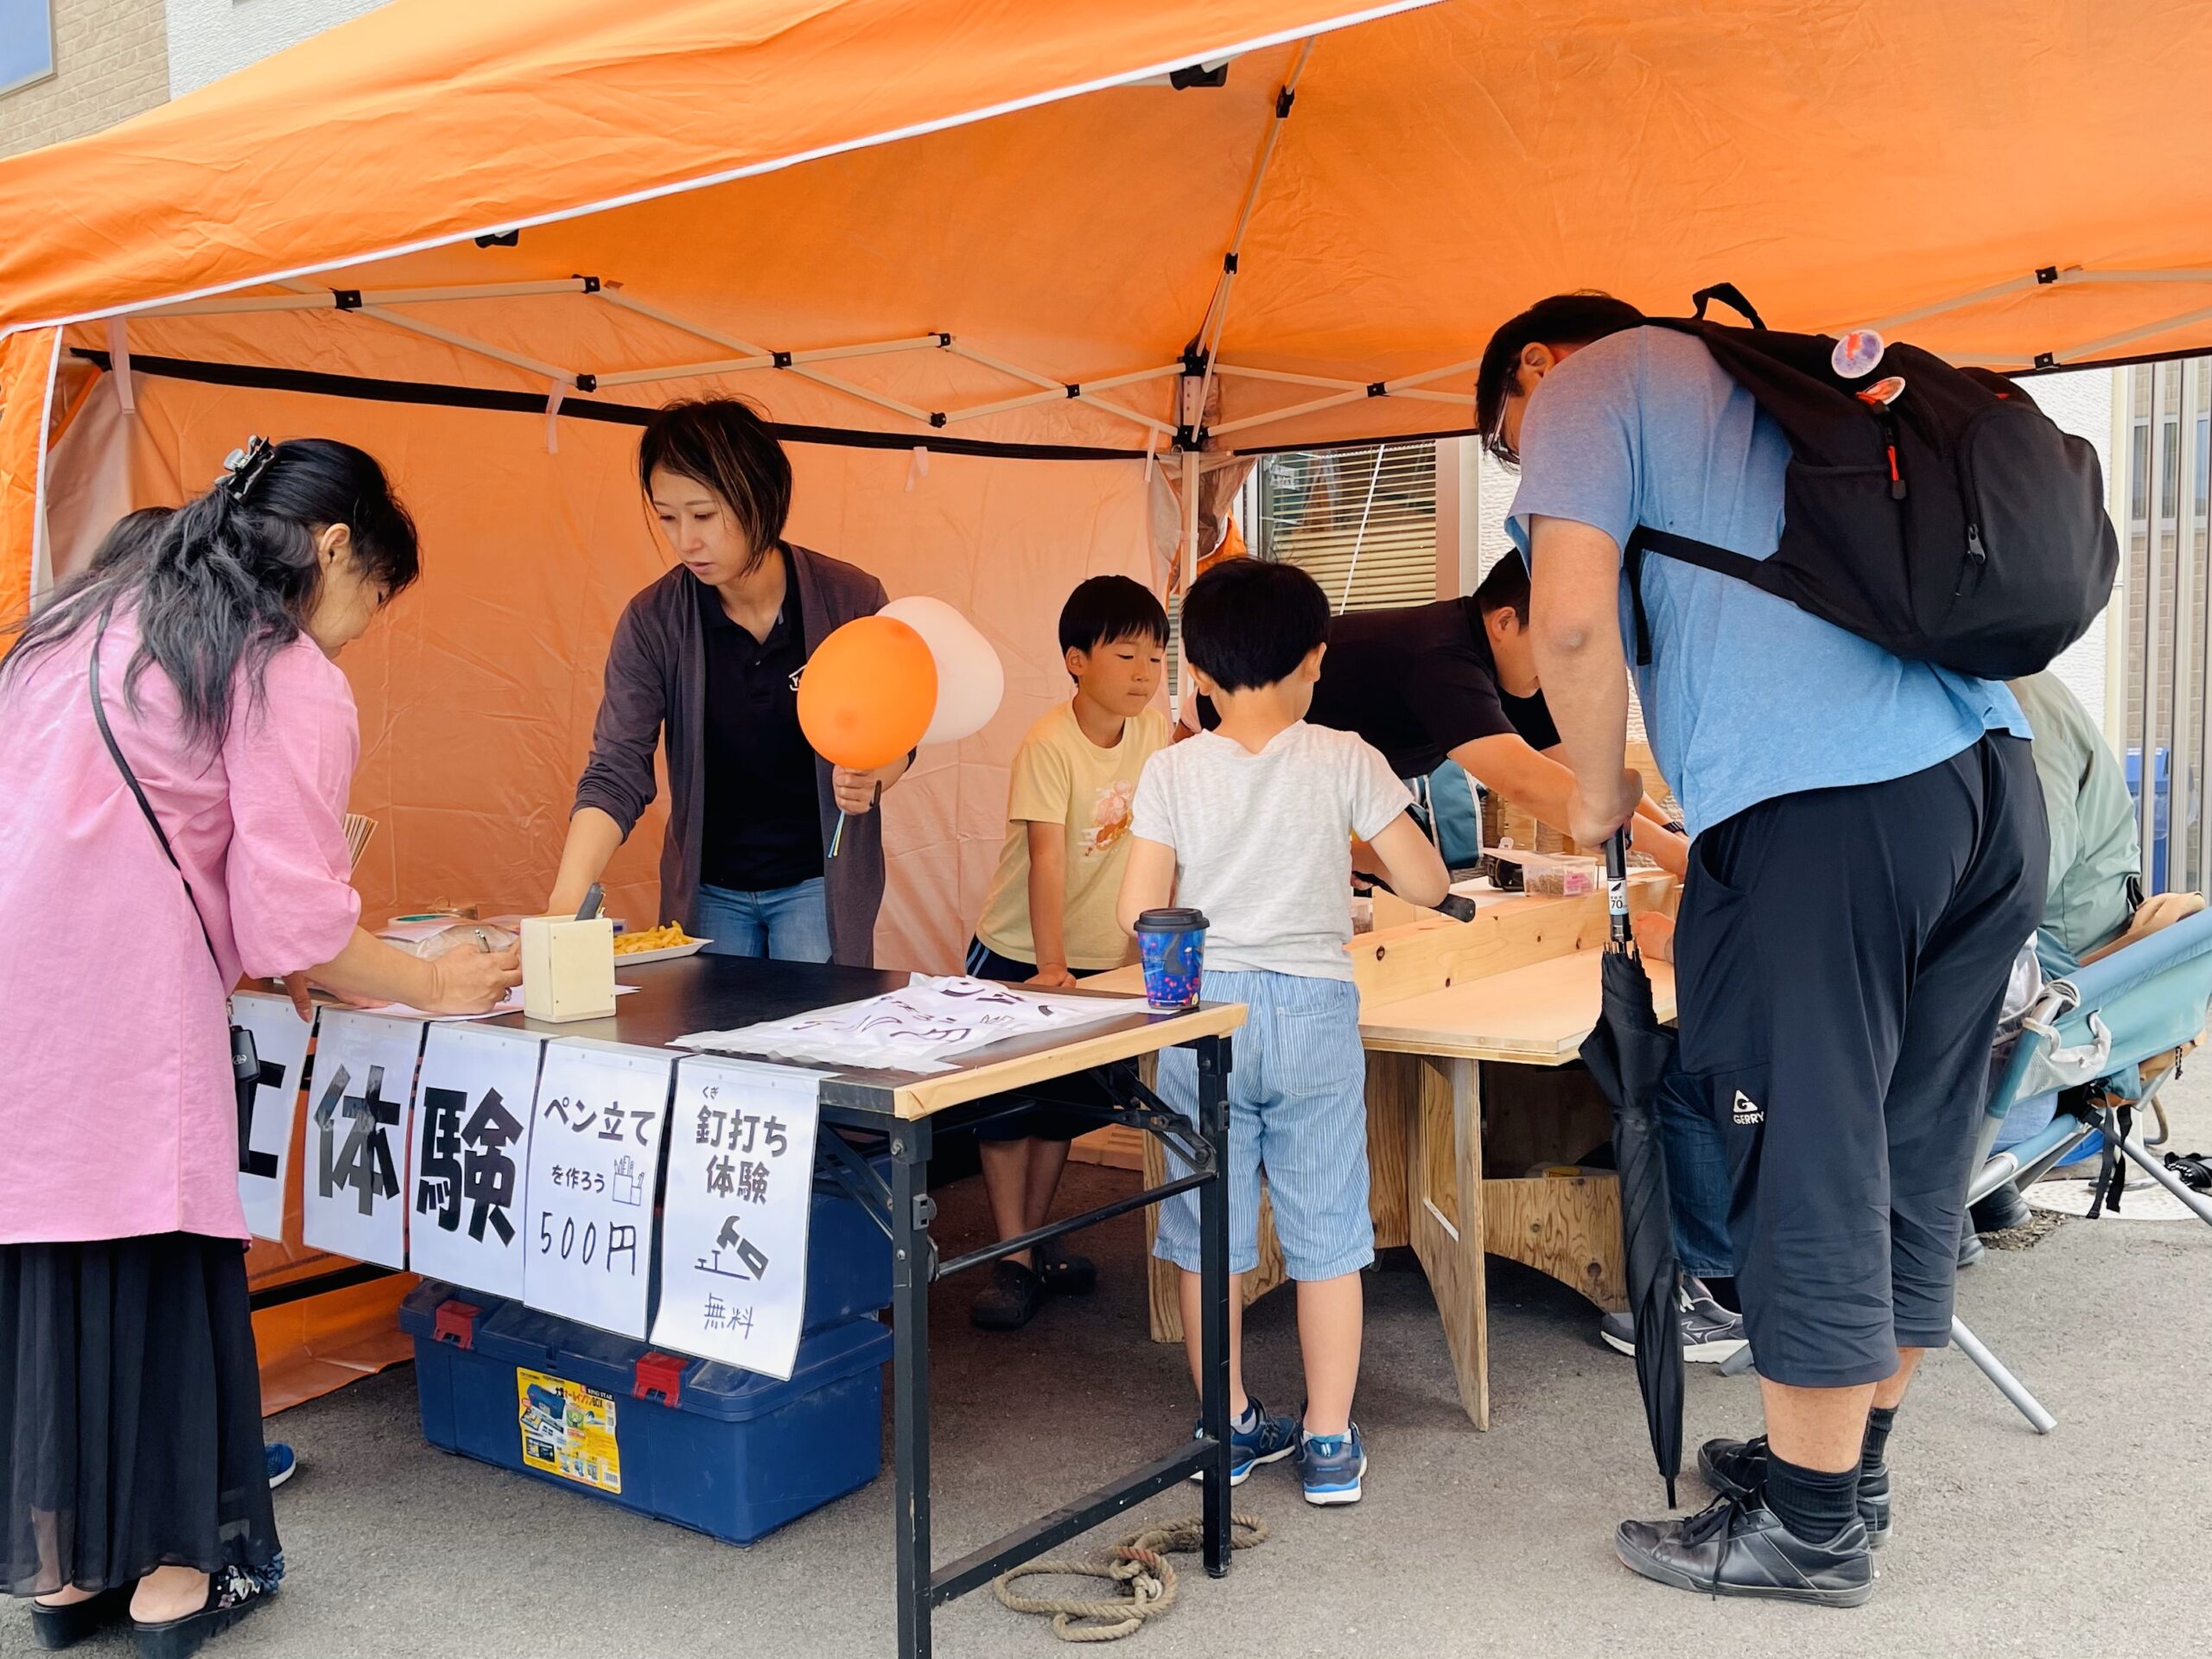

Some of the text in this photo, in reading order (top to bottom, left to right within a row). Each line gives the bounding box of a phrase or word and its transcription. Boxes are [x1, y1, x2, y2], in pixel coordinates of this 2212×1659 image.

[1611, 899, 1623, 909] 70
[702, 1085, 719, 1100] くぎ
[543, 1096, 656, 1147] ペン立て
[696, 1104, 787, 1158] 釘打ち
[1733, 1111, 1764, 1124] GERRY
[551, 1164, 605, 1193] を作ろう
[706, 1154, 770, 1205] 体験
[541, 1211, 636, 1276] 500円
[704, 1293, 753, 1339] 無料
